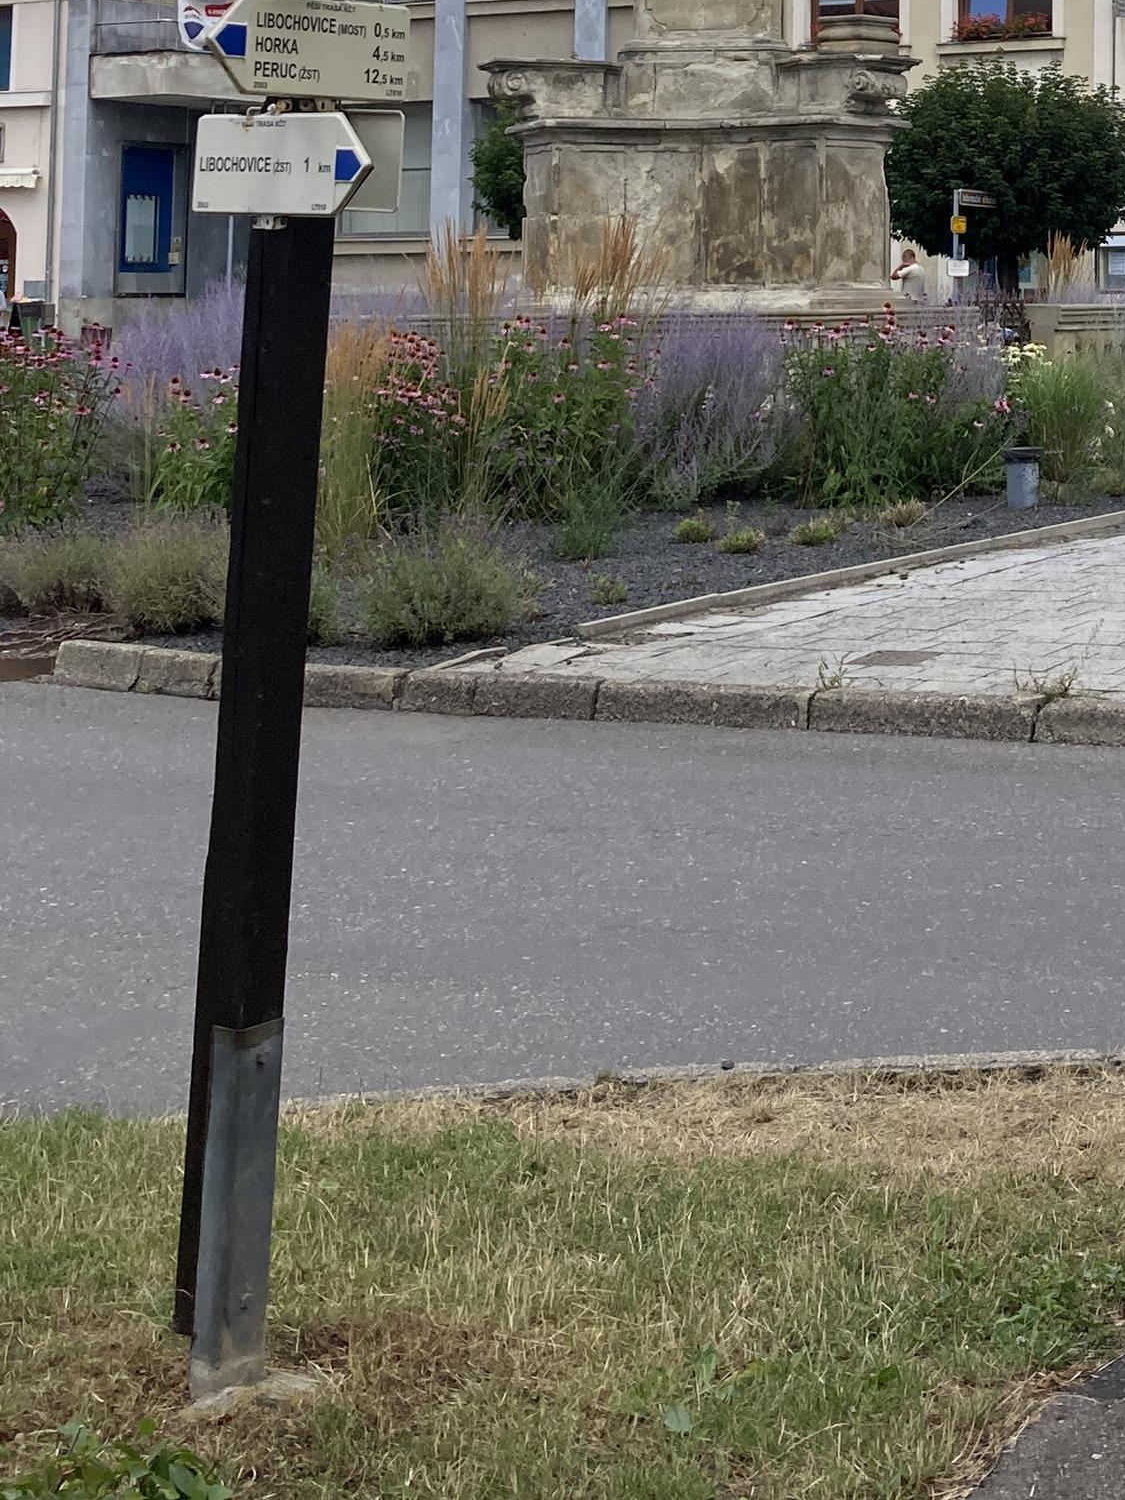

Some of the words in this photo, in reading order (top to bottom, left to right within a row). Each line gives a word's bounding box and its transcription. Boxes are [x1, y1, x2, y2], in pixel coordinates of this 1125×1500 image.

[322, 3, 343, 12] TRASA
[257, 12, 336, 34] LIBOCHOVICE
[338, 24, 367, 38] (MOST)
[374, 22, 390, 38] 0,5
[392, 30, 405, 39] km
[255, 36, 298, 54] HORKA
[373, 46, 389, 62] 4,5
[391, 52, 404, 63] km
[254, 61, 297, 79] PERUC
[298, 67, 320, 82] (ŽST)
[364, 68, 387, 86] 12,5
[390, 76, 403, 86] km
[199, 156, 271, 173] LIBOCHOVICE
[272, 158, 292, 174] (ŽST)
[304, 158, 310, 172] 1
[318, 162, 331, 172] km
